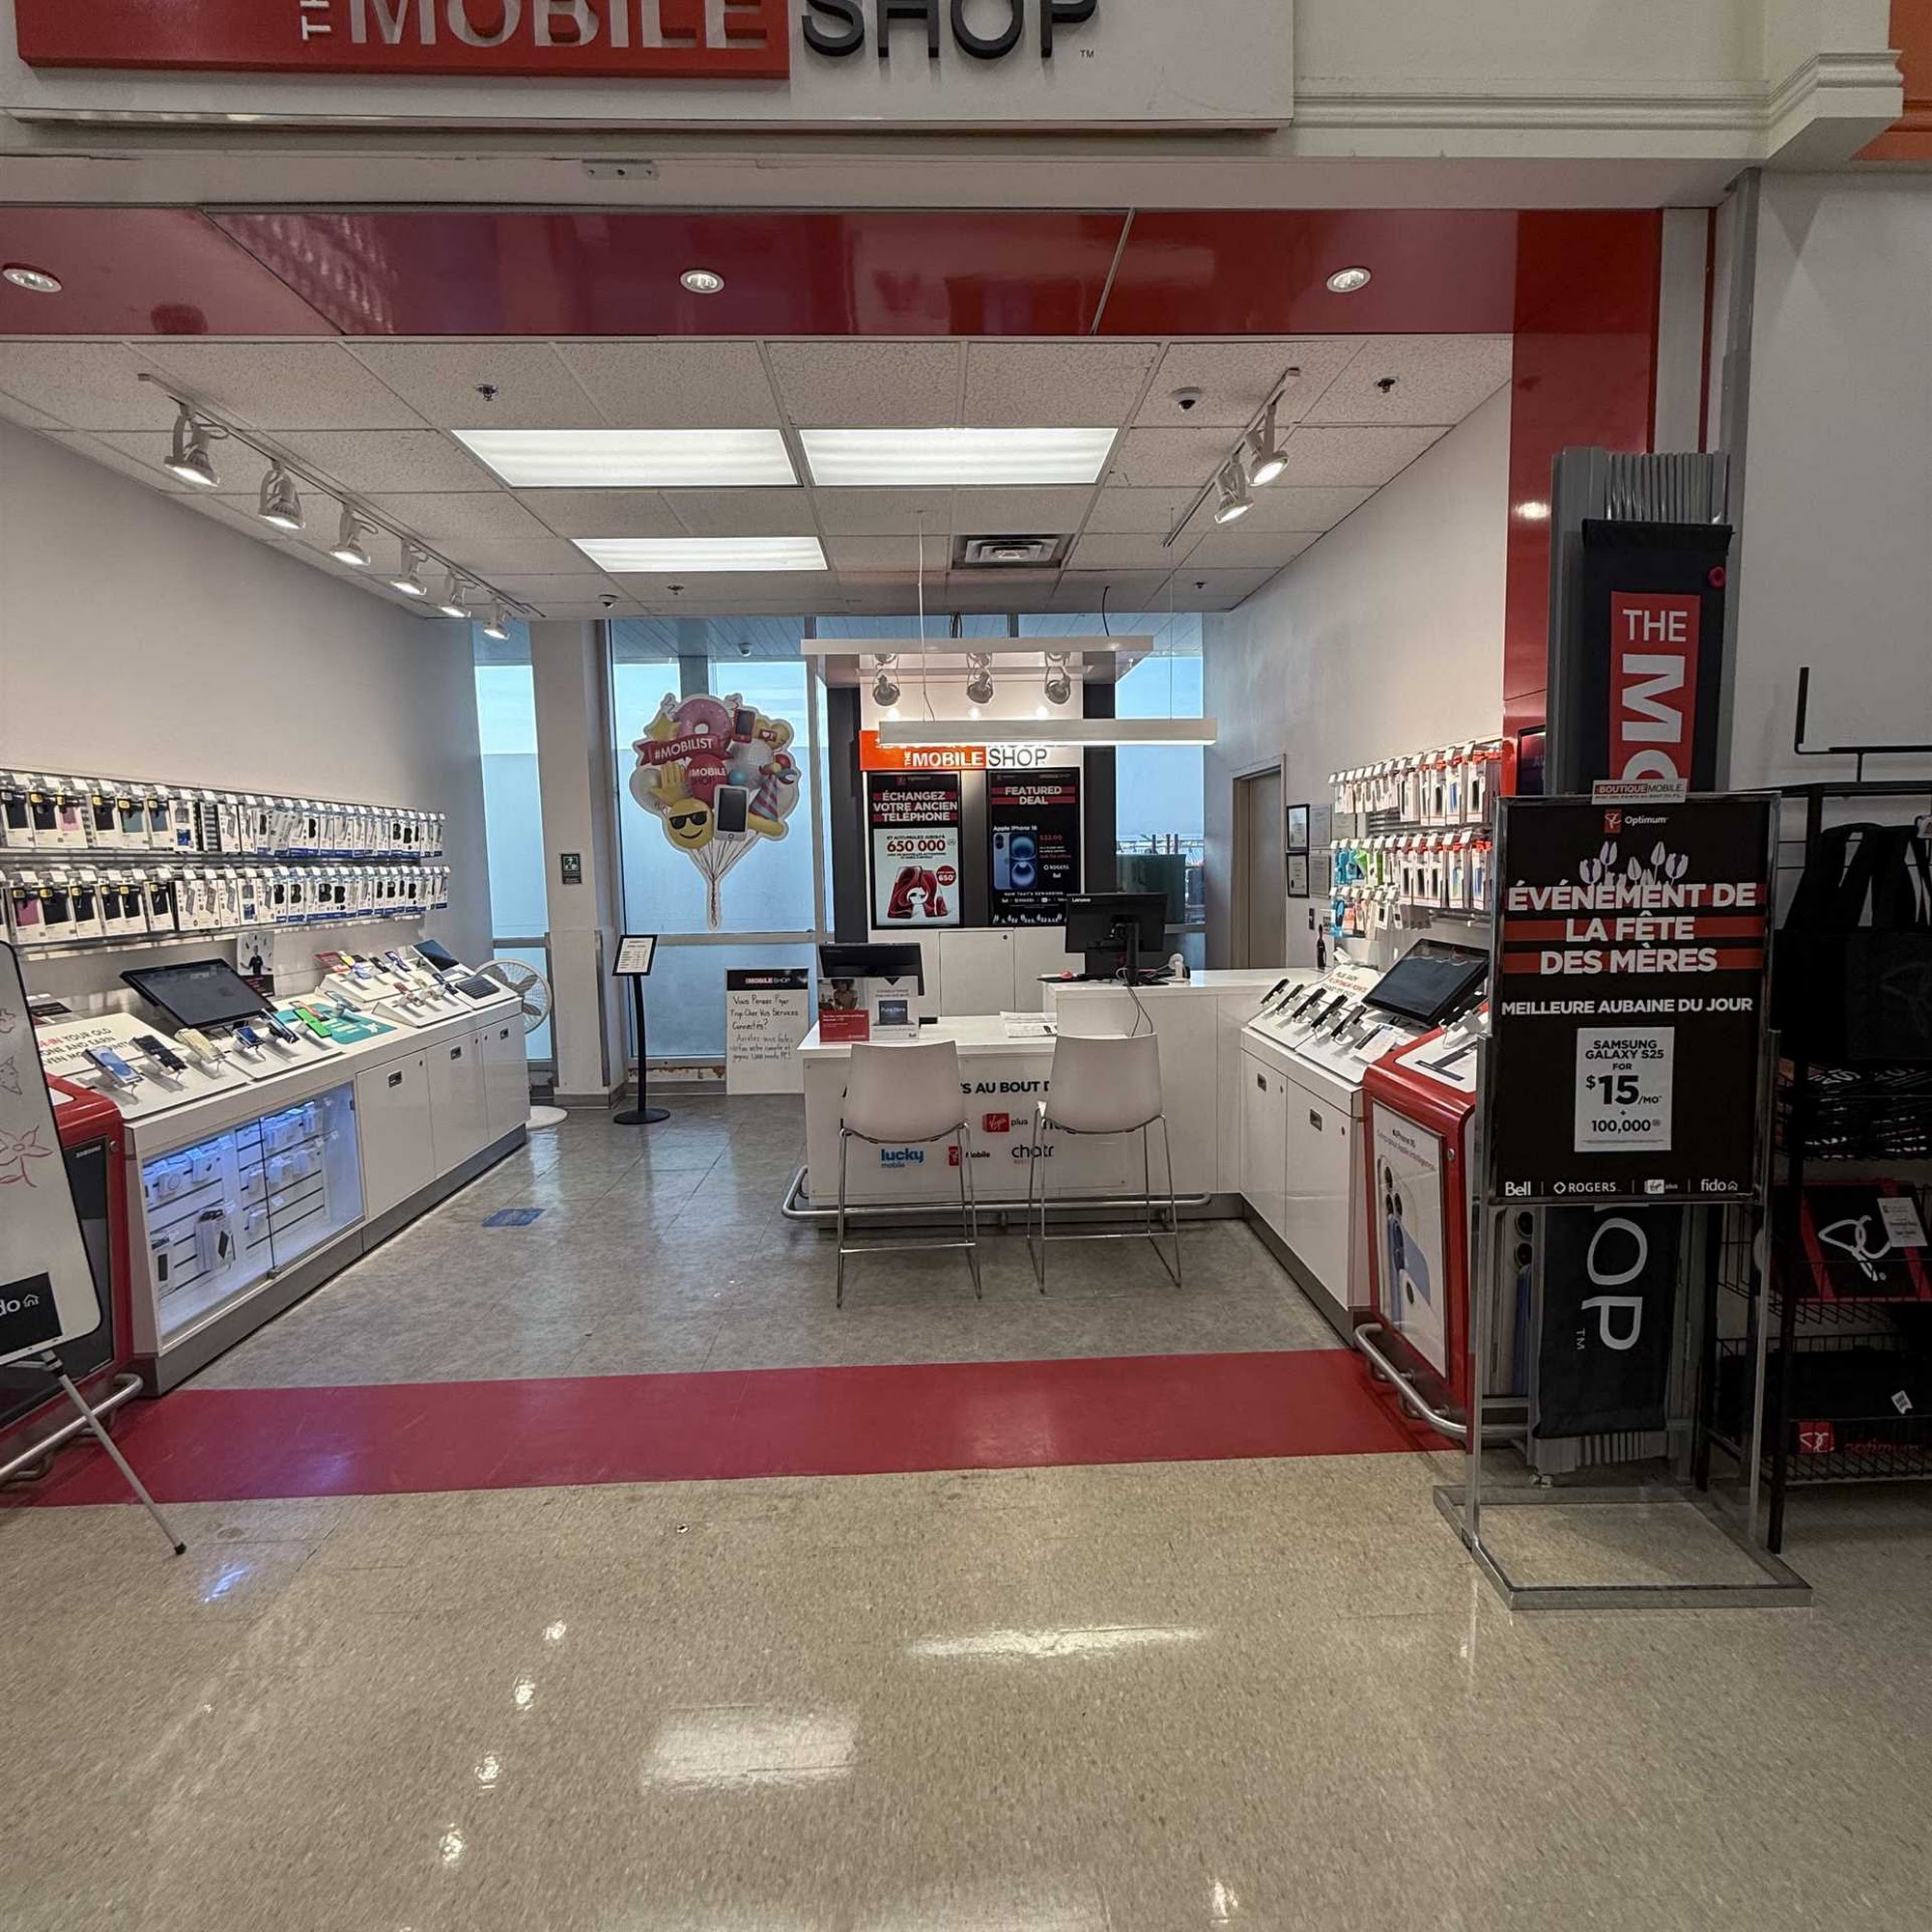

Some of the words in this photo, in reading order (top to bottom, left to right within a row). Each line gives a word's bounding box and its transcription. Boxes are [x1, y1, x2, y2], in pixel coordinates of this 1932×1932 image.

[1622, 609, 1688, 642] THE
[913, 751, 984, 767] MOBILE
[988, 748, 1047, 767] SHOP
[1005, 785, 1062, 795] FEATURED
[1599, 784, 1647, 794] BOUTIQUE
[1647, 782, 1683, 793] MOBILE
[882, 789, 946, 801] ÉCHANGEZ
[1019, 796, 1048, 805] DEAL
[873, 802, 911, 811] VOTRE
[915, 801, 957, 810] ANCIEN
[882, 810, 950, 821] TÉLÉPHONE
[1624, 815, 1667, 826] Optimum
[887, 840, 914, 852] 650
[918, 839, 946, 851] 000
[1508, 880, 1706, 911] ÉVÉNEMENT
[1713, 883, 1757, 906] DE
[1565, 919, 1608, 942] LA
[1616, 911, 1695, 941] FÊTE
[1540, 951, 1604, 974] DES
[1609, 942, 1719, 973] MÈRES
[1501, 1001, 1595, 1014] MEILLEURE
[1598, 999, 1675, 1013] AUBAINE
[1678, 999, 1703, 1012] DU
[1706, 998, 1753, 1011] JOUR
[66, 1042, 89, 1052] AND
[1593, 1039, 1658, 1049] SAMSUNG
[1585, 1050, 1637, 1059] GALAXY
[1641, 1049, 1664, 1059] S25
[976, 1082, 996, 1094] AU
[1000, 1081, 1040, 1093] BOUT
[1592, 1120, 1651, 1133] 100,000
[880, 1148, 924, 1163] lucky
[1504, 1180, 1531, 1196] Bell
[1568, 1181, 1616, 1192] ROGERS
[1700, 1179, 1726, 1192] fido
